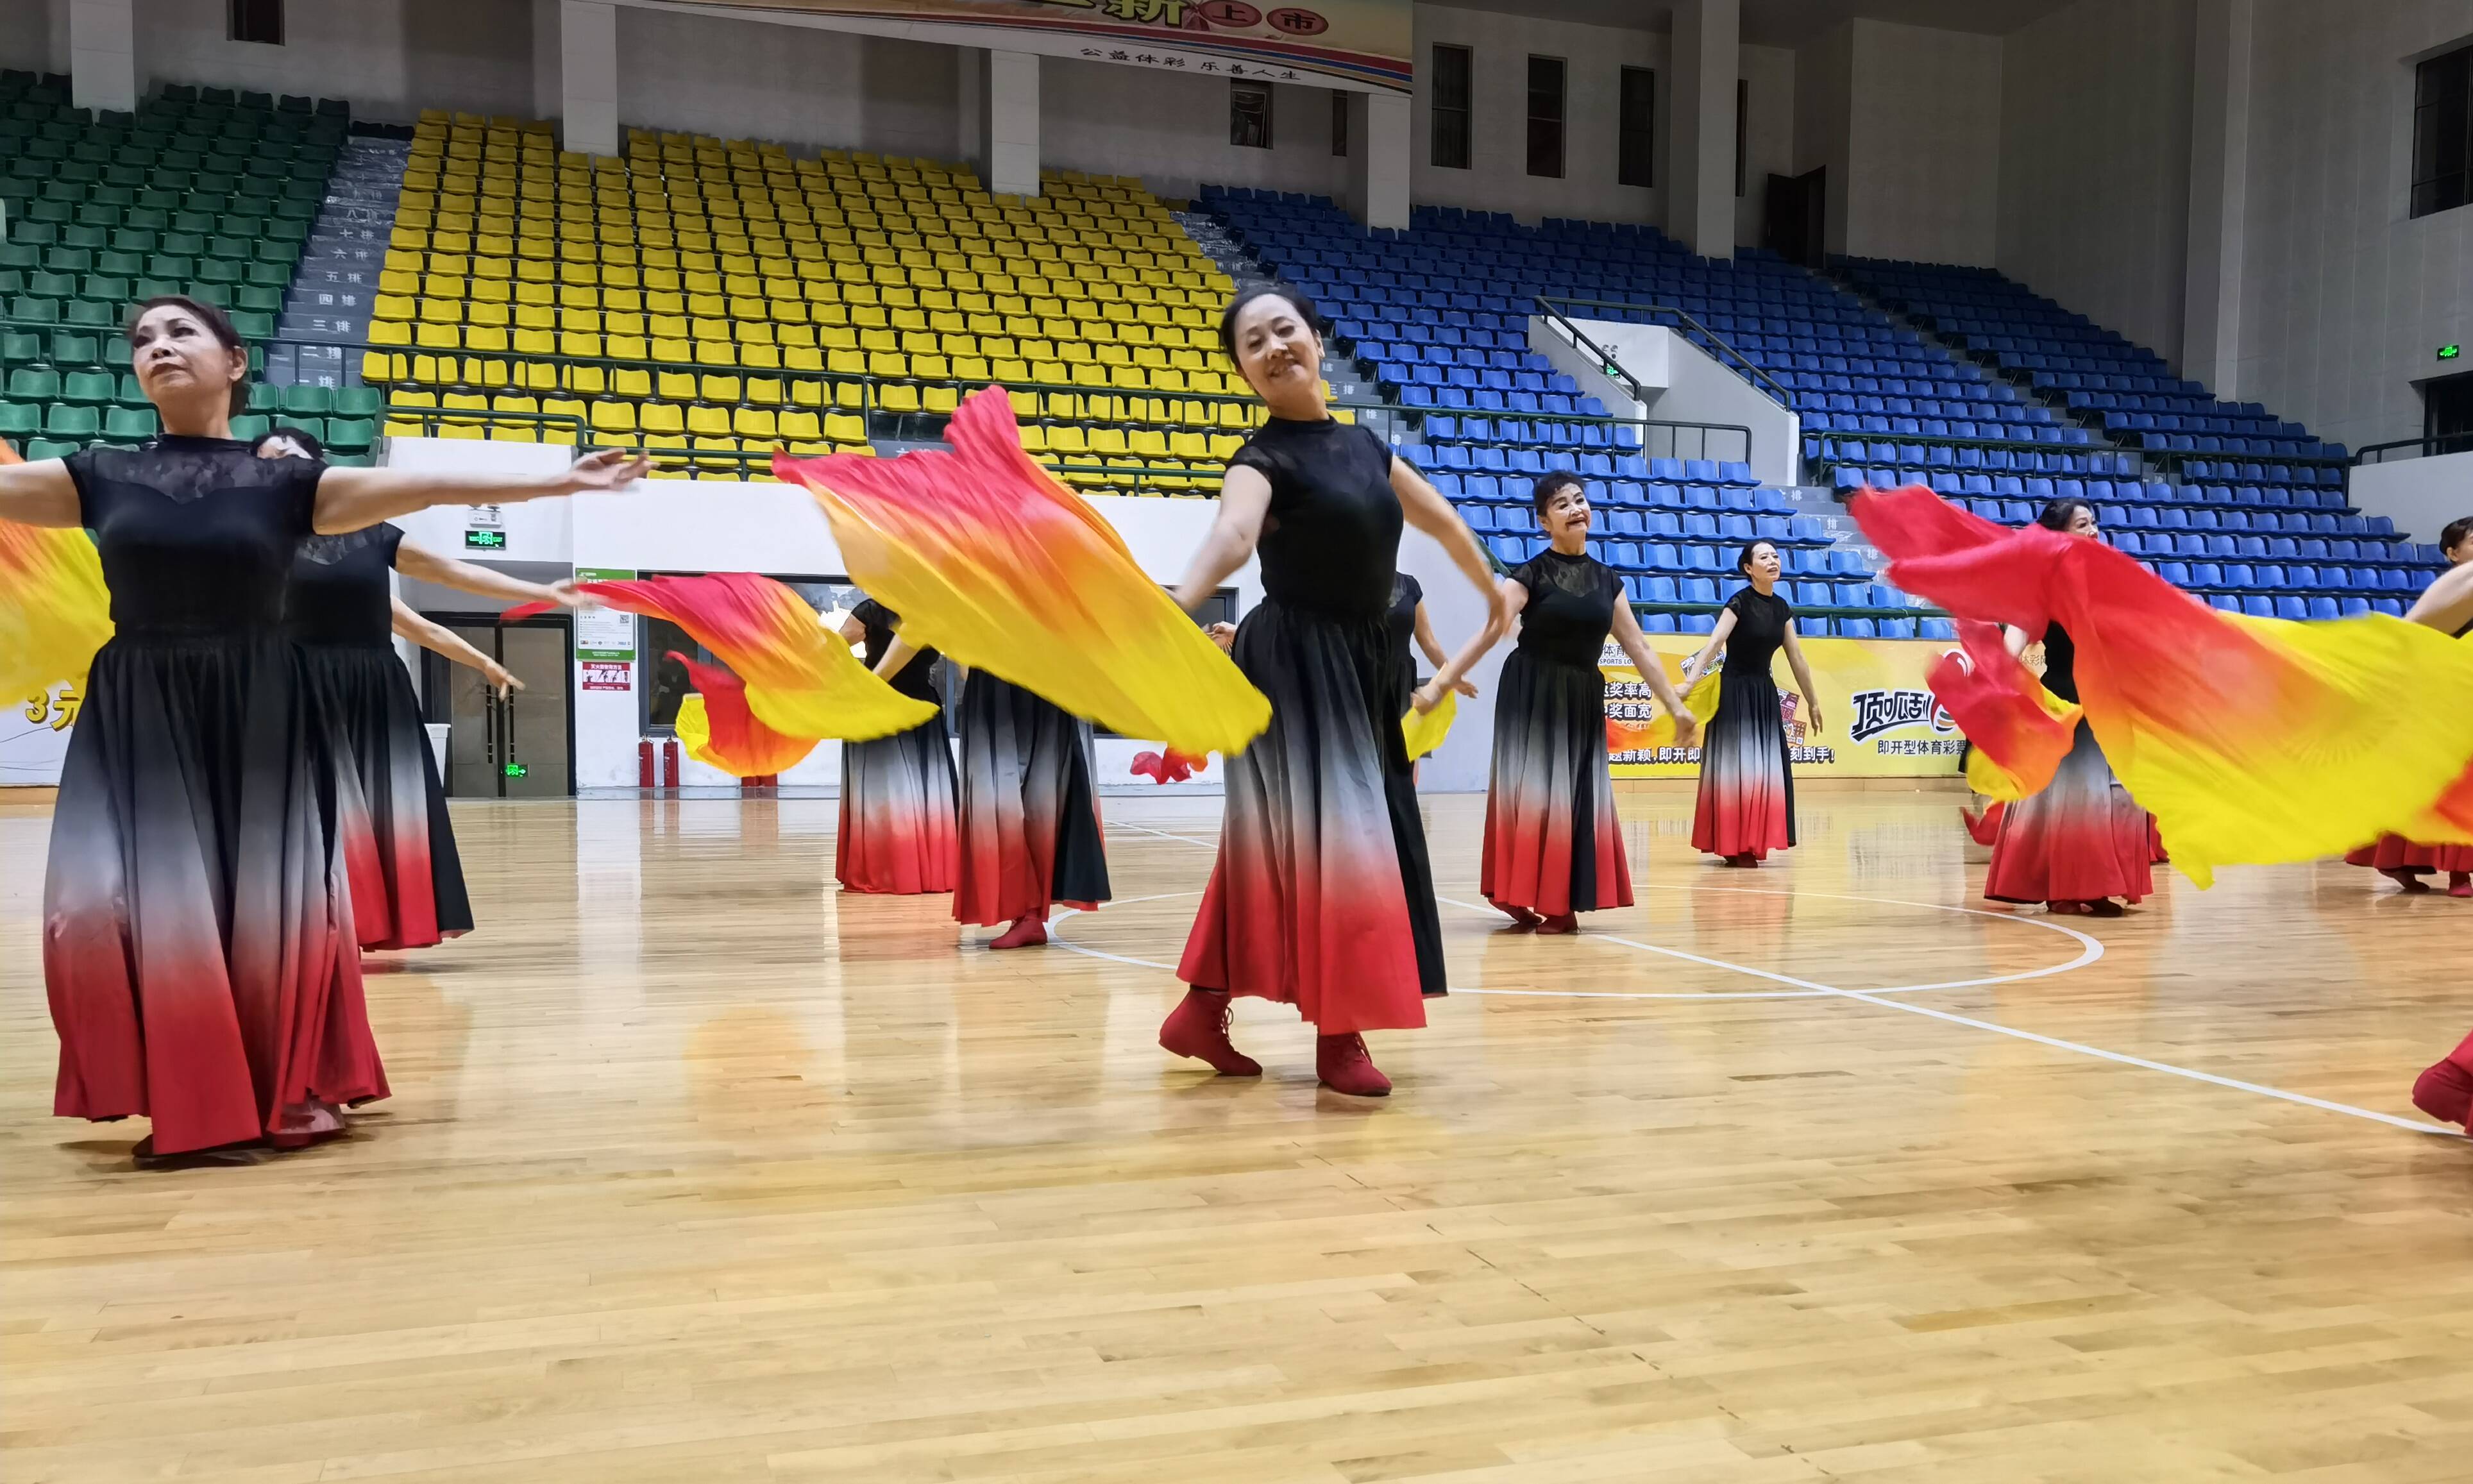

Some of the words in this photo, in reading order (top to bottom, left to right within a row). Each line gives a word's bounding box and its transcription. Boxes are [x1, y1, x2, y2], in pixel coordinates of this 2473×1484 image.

[1080, 48, 1185, 67] 公益体彩
[1201, 62, 1301, 80] 乐善人生
[325, 271, 362, 283] 五排
[319, 294, 357, 307] 四排
[312, 319, 351, 333] 三排
[1851, 691, 1932, 736] 顶呱刮
